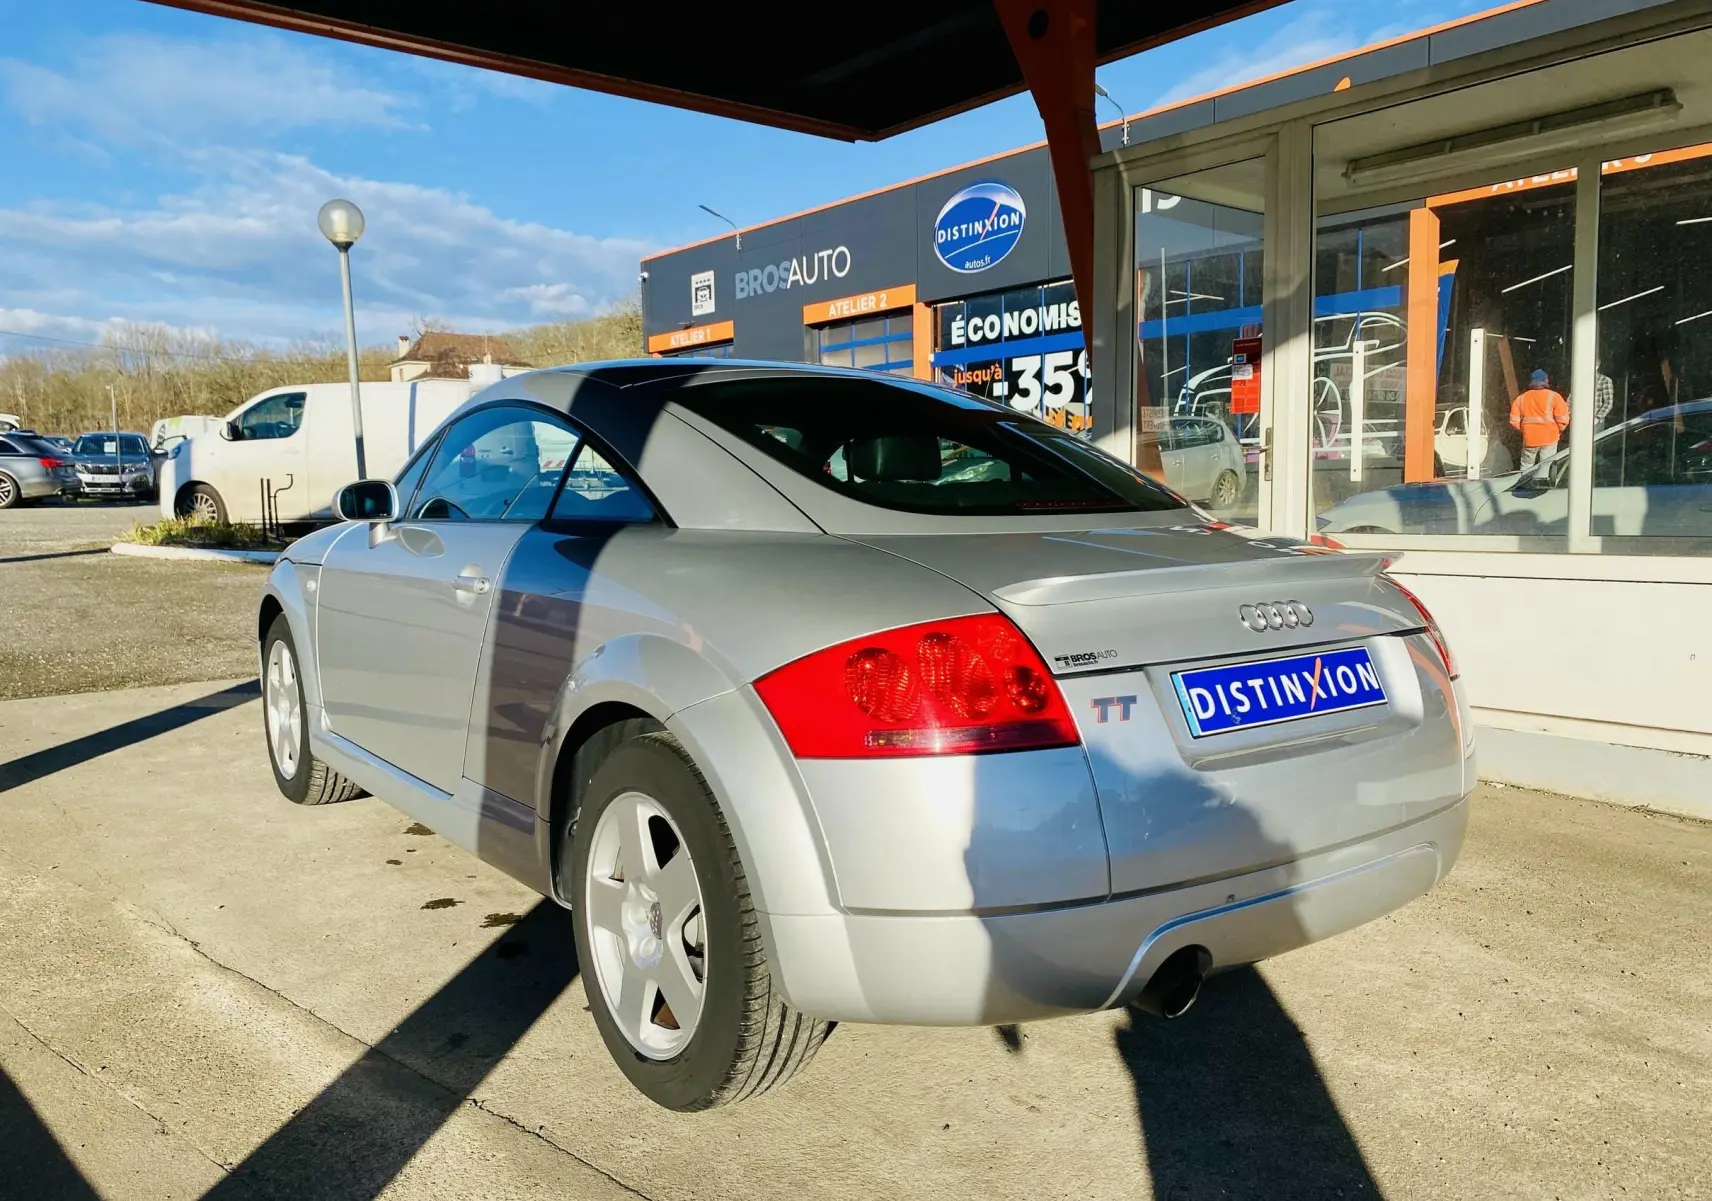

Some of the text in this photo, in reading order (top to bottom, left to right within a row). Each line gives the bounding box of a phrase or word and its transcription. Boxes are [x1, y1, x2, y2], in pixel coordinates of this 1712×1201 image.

[937, 204, 1020, 244] DISTINXION
[964, 255, 991, 269] autos.fr
[829, 293, 887, 317] ATELIER 2
[670, 327, 711, 348] ATELIER 1
[953, 363, 1003, 387] jusqu'à
[1189, 657, 1380, 720] DISTINXION
[1090, 694, 1137, 723] TT
